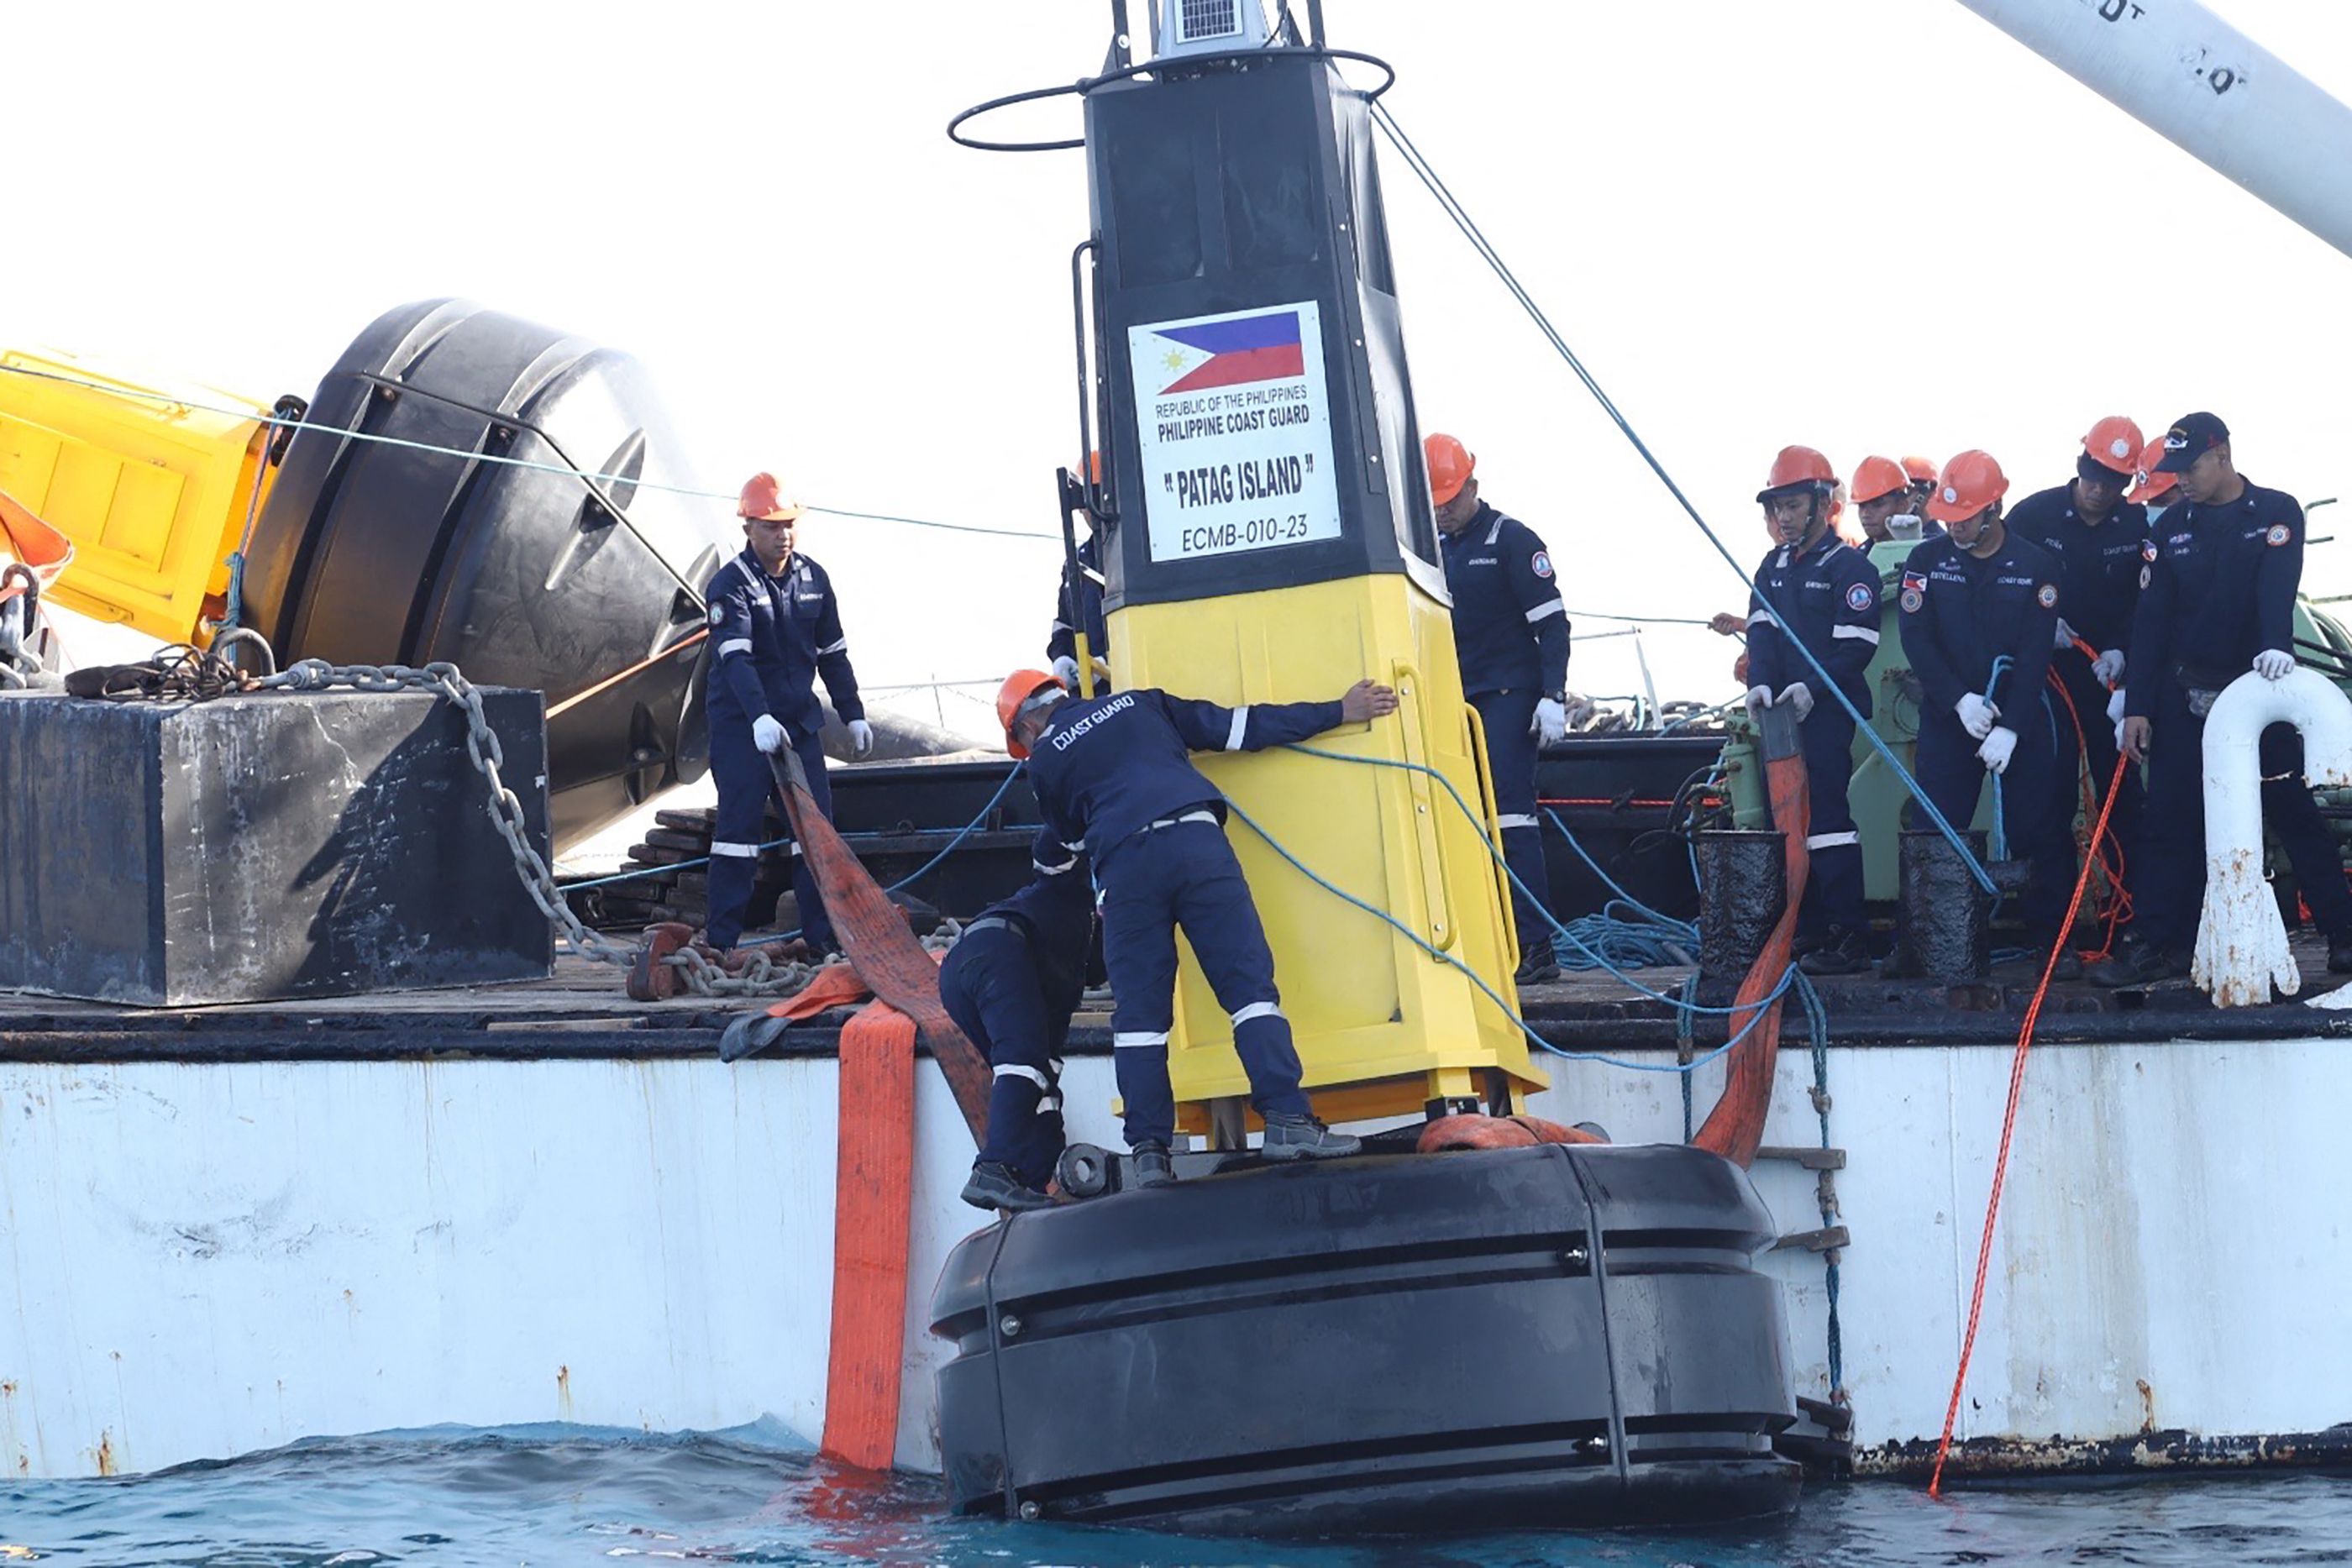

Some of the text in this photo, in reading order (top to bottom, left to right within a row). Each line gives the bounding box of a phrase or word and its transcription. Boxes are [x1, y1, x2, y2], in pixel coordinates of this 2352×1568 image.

[1156, 385, 1308, 419] REPUBLIC OF THE PHILIPPINES
[1158, 404, 1310, 443] PHILIPPINE COAST GUARD
[1182, 514, 1308, 553] ECMB-010-23
[1052, 695, 1135, 752] COAST GUARD
